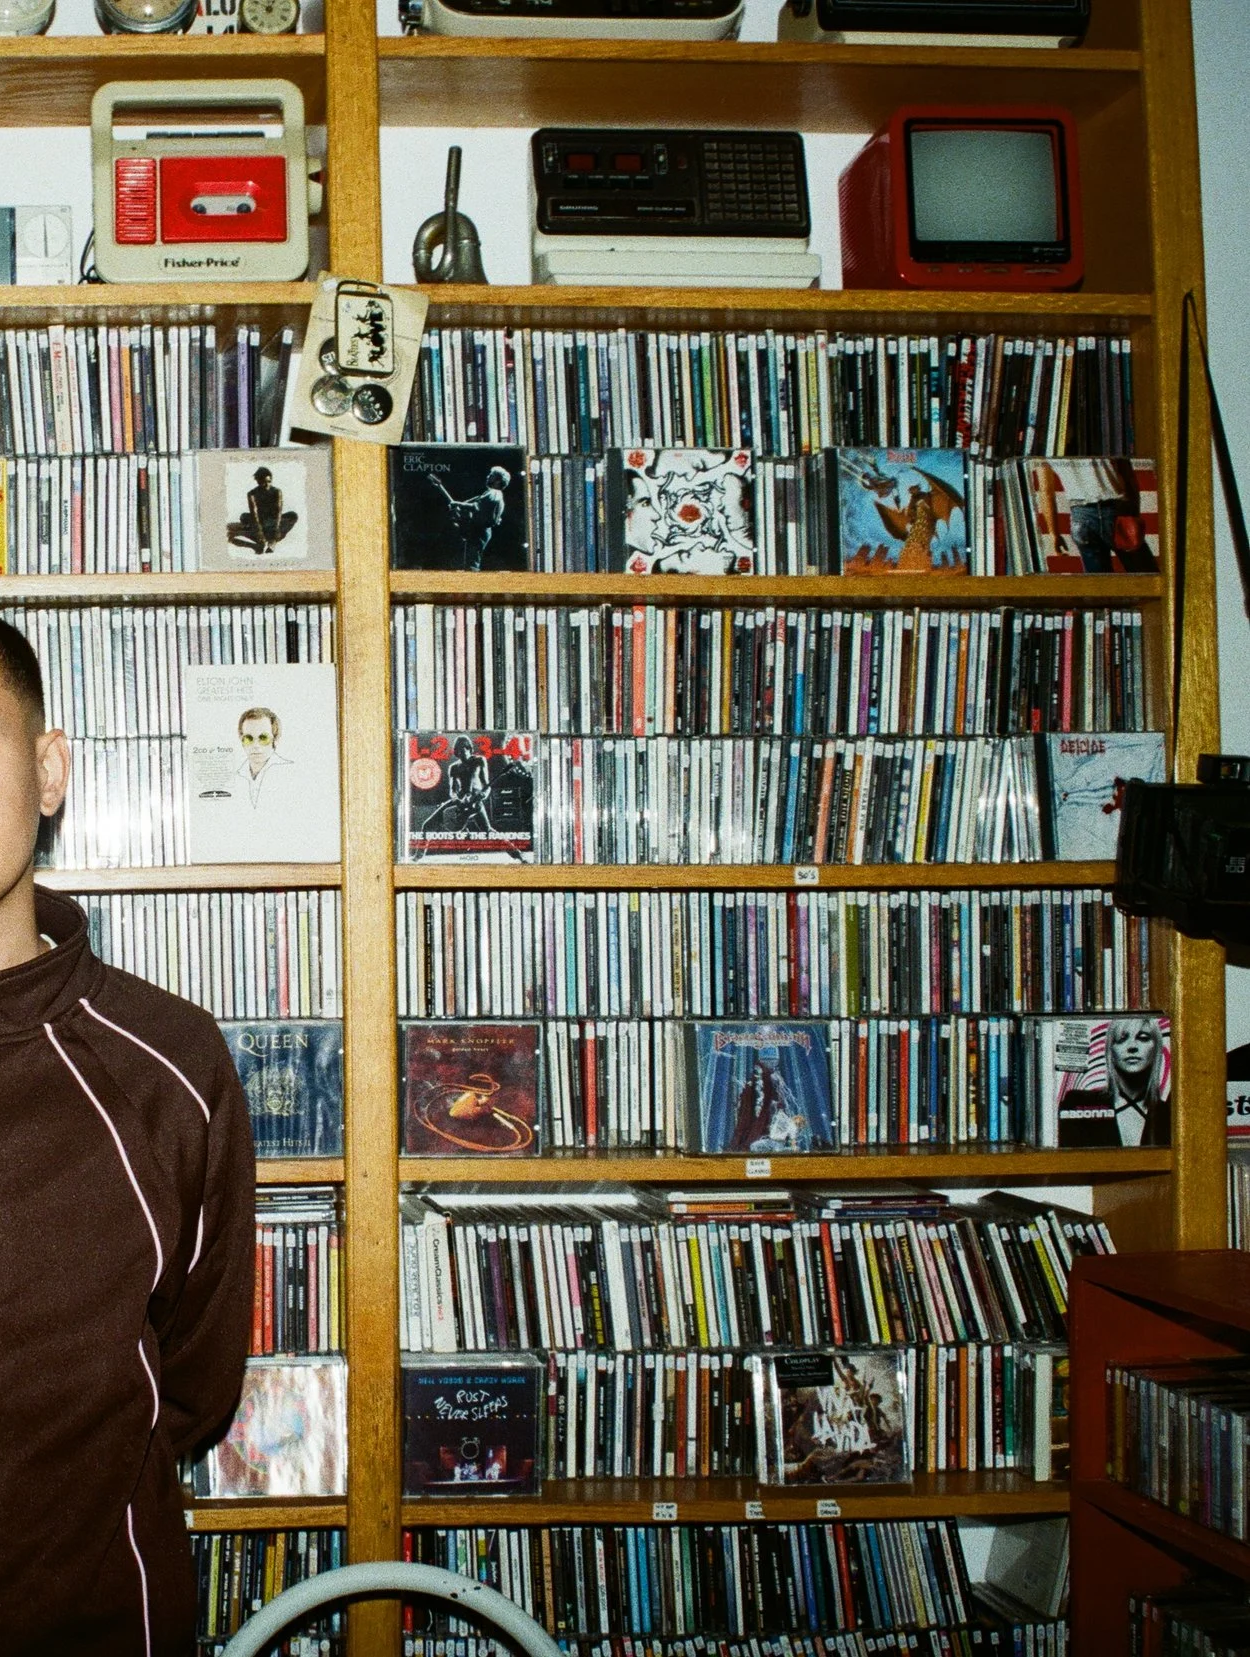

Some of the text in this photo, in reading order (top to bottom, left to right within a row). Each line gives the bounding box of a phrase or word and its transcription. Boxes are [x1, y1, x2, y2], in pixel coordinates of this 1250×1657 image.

[164, 258, 240, 268] Fisher-Price
[403, 456, 426, 464] ERIC
[403, 464, 451, 472] CLAPTON
[196, 676, 254, 686] ELTON JOHN
[197, 686, 234, 695] GREATEST
[409, 832, 531, 840] THE ROOTS OF THE RAMONES
[237, 1032, 308, 1057] QUEEN
[784, 1357, 820, 1365] COLDPLAY
[456, 1390, 491, 1404] RUST
[434, 1395, 508, 1422] NEVER SLEEPS
